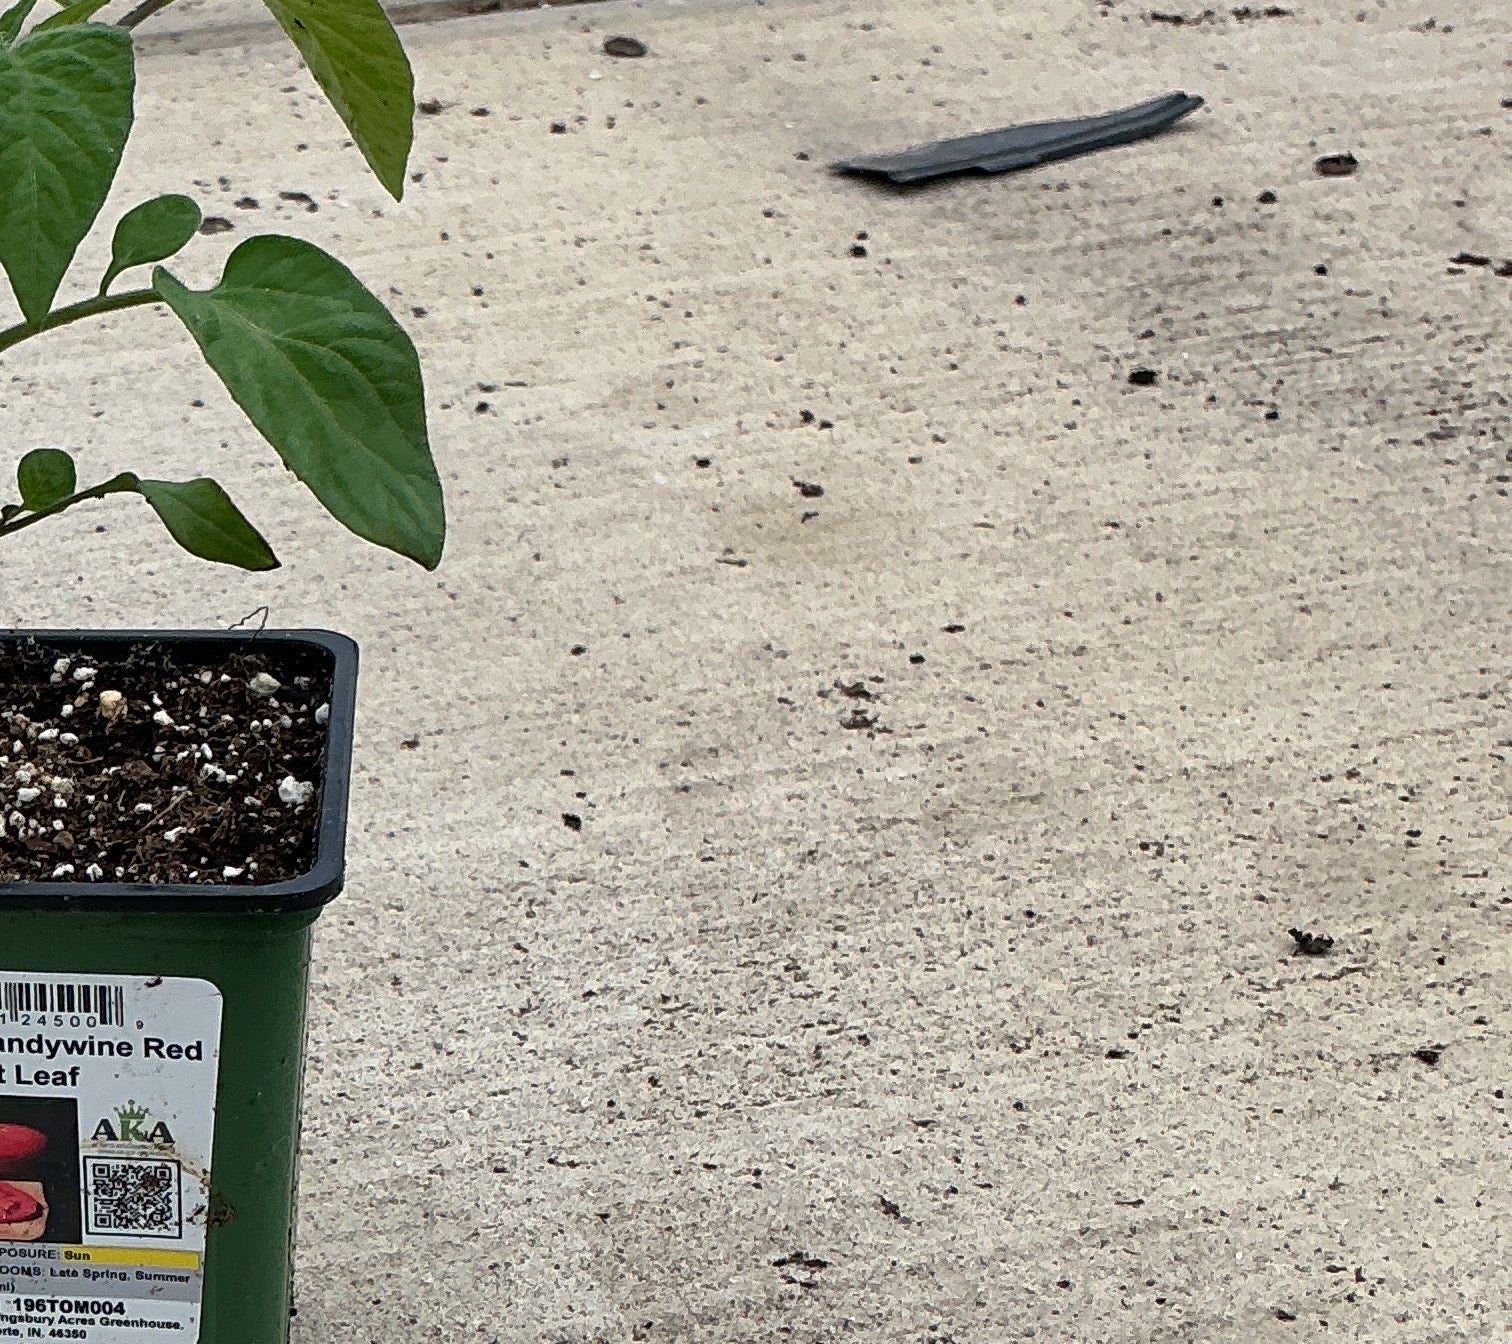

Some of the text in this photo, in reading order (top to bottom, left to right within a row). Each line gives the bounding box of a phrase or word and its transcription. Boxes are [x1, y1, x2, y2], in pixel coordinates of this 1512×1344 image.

[21, 1013, 97, 1028] 24500
[144, 1037, 202, 1061] Red
[15, 1064, 80, 1087] Leaf
[91, 1118, 175, 1143] AKA
[64, 1250, 91, 1261] Sun
[50, 1267, 78, 1278] Late
[83, 1269, 130, 1281] Spring,
[135, 1271, 190, 1283] Summer
[12, 1298, 126, 1315] 196TOM004
[58, 1317, 95, 1326] Acres
[48, 1328, 87, 1339] 46350
